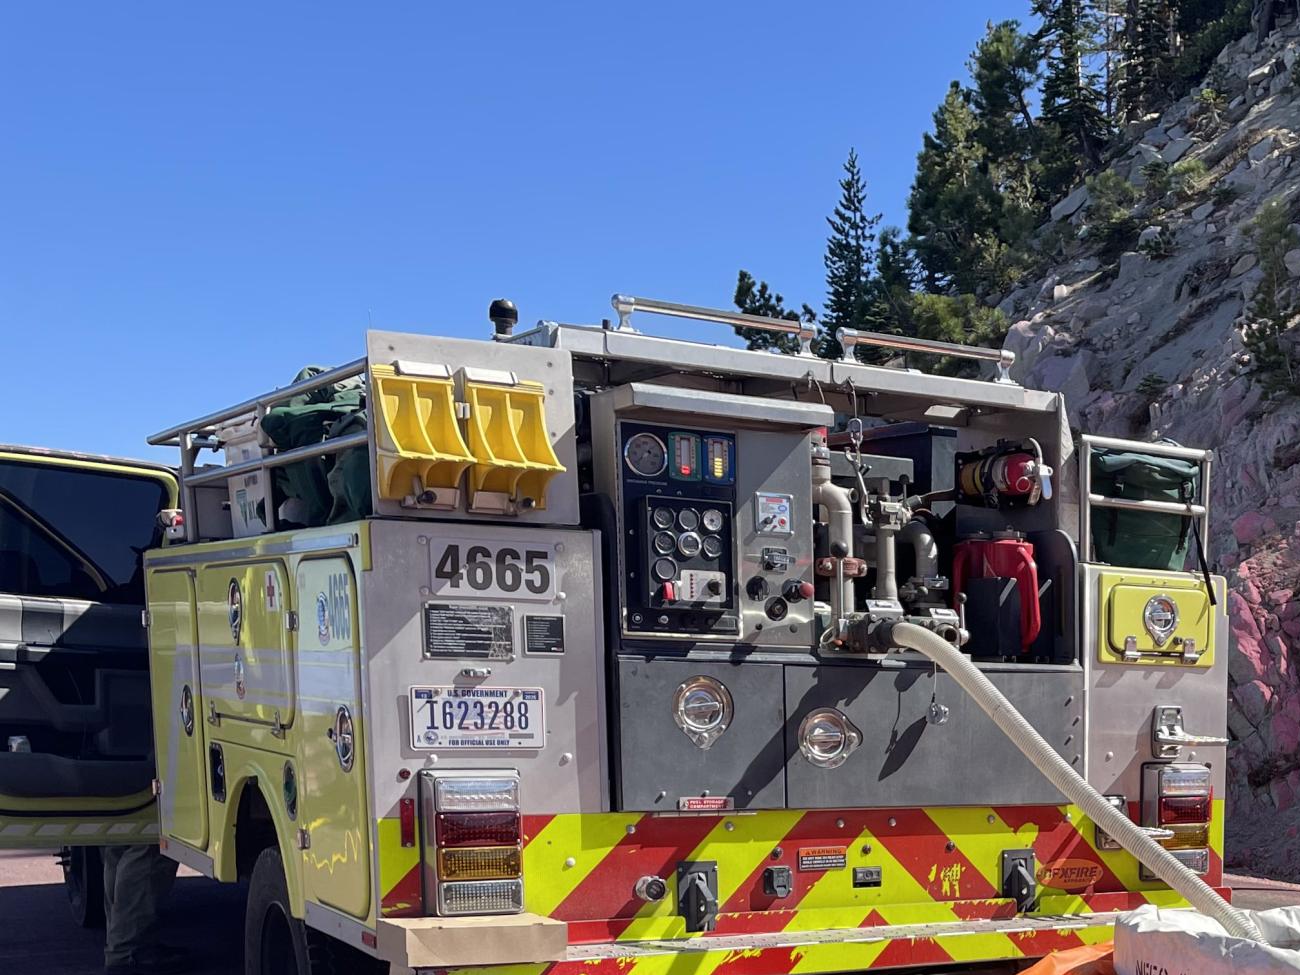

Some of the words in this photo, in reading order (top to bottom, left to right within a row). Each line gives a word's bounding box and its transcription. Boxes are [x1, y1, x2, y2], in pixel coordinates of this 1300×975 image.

[435, 544, 550, 594] 4665
[328, 572, 350, 640] 4665
[447, 689, 460, 698] U.S.
[461, 689, 508, 698] GOVERNMENT
